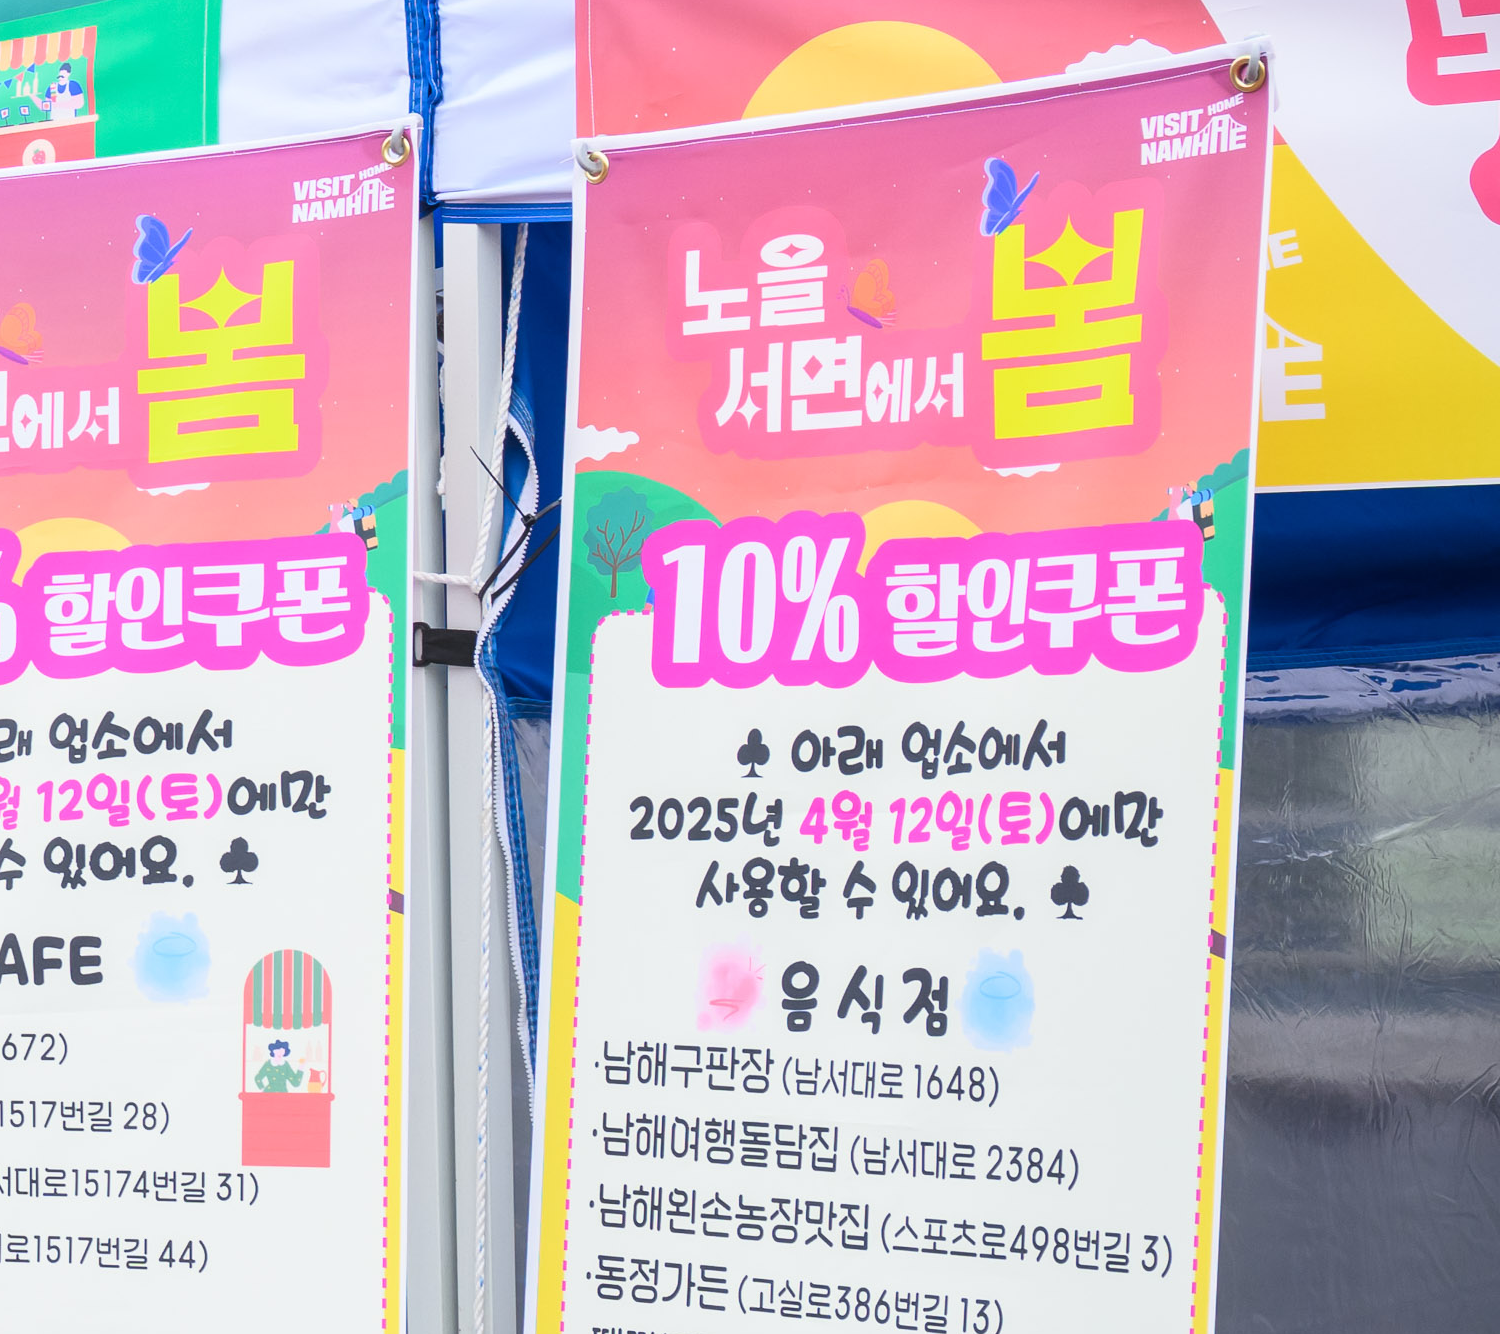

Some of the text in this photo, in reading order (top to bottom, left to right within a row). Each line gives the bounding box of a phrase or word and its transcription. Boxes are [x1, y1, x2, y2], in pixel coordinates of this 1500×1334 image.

[1140, 93, 1244, 141] VISIT HOME
[1140, 115, 1247, 165] NAMHAE
[291, 181, 395, 223] NAMHAE
[293, 164, 393, 202] VISIT HOME
[682, 234, 828, 336] 노을
[715, 208, 1144, 440] 서면에서 봄
[137, 260, 305, 464] 봄
[44, 557, 352, 658] 할인쿠폰
[661, 535, 1187, 665] 10% 할인쿠폰
[49, 708, 234, 760] 업소에서
[791, 718, 1066, 780] 아래 업소에서
[37, 770, 331, 828] 12일(토)에만
[630, 789, 1162, 852] 2025년 4월 12일(토)에만
[44, 837, 195, 891] 있어요.
[695, 858, 1025, 920] 사용할 수 있어요.
[1, 1032, 68, 1065] 672)
[782, 1056, 904, 1099] (남서대로
[914, 1064, 999, 1108] 1648)
